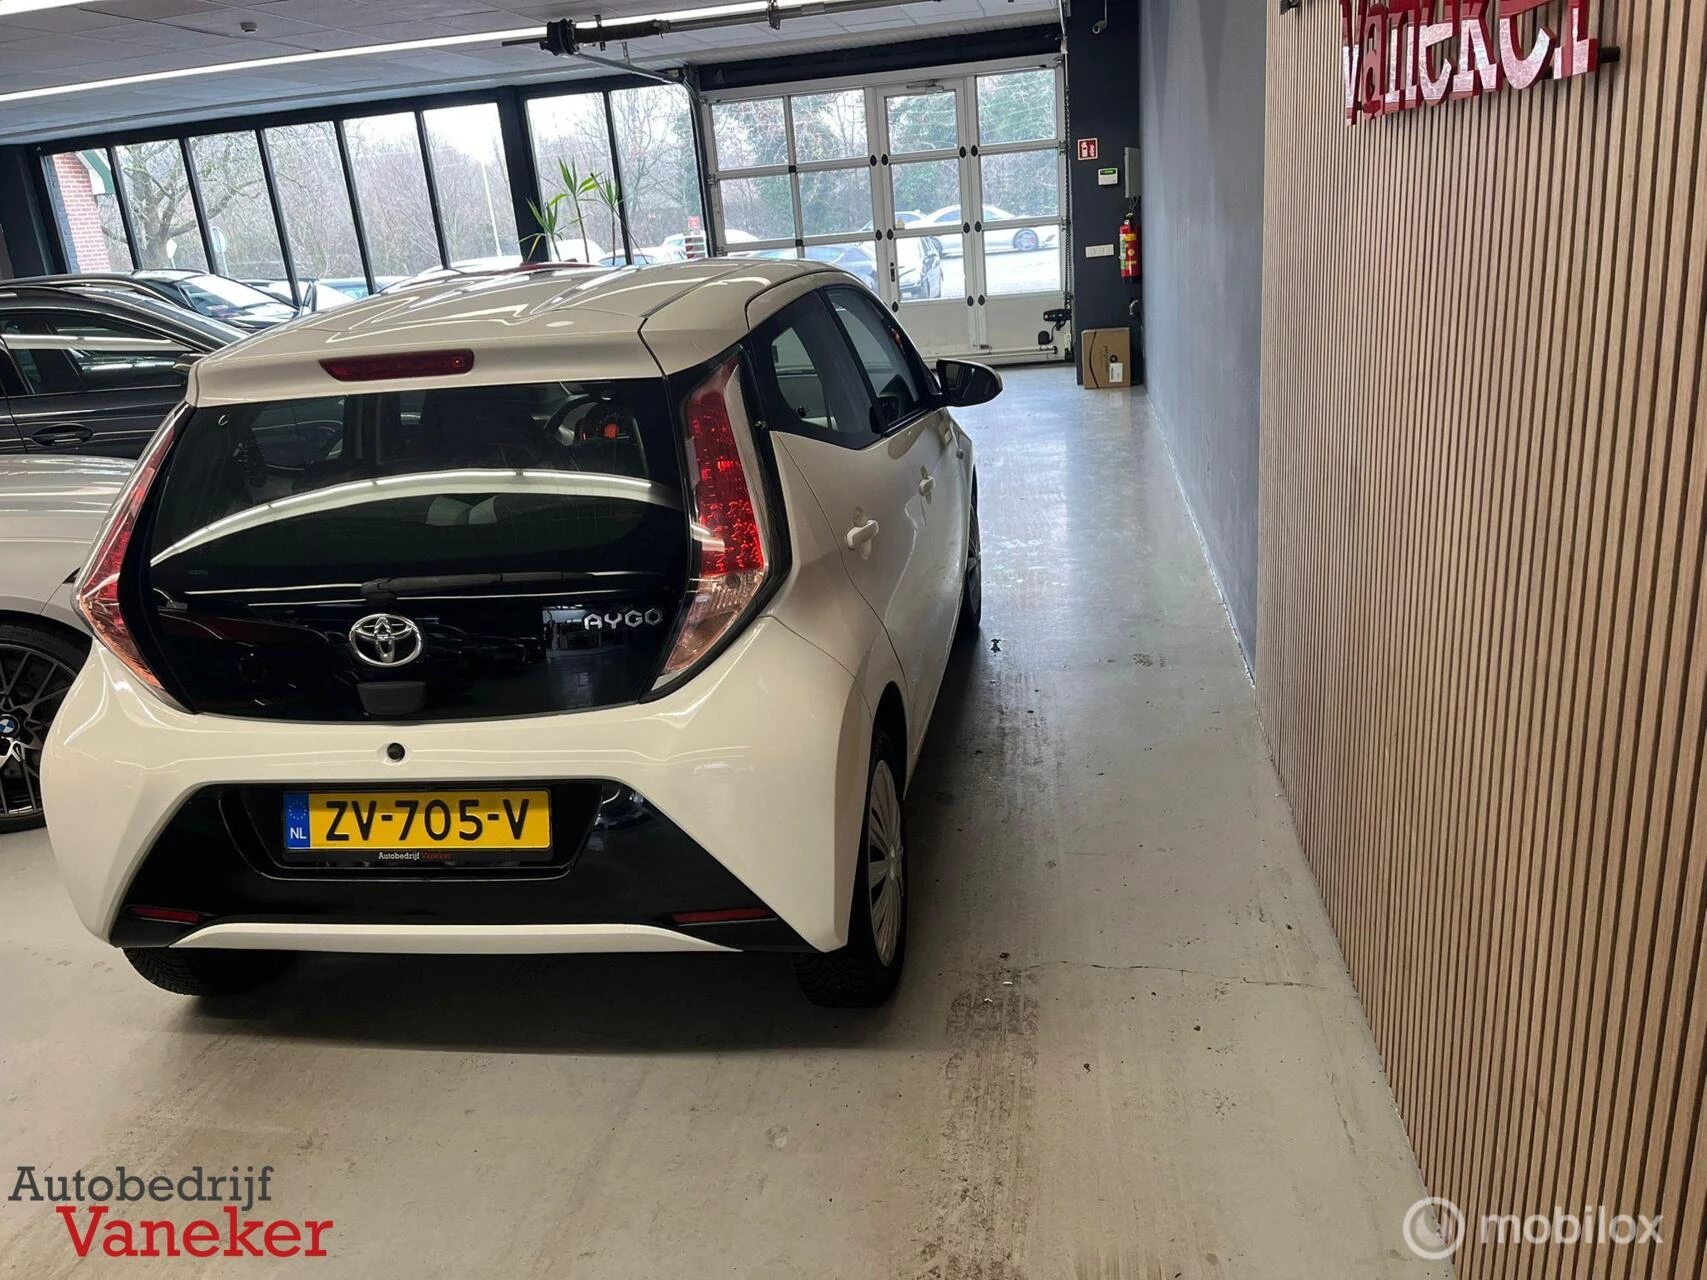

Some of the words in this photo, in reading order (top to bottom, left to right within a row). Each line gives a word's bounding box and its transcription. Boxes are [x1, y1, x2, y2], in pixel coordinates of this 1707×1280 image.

[584, 608, 663, 630] AYGO
[325, 799, 529, 841] ZV-705-V
[290, 826, 307, 840] NL
[378, 851, 420, 861] Autobedrijf
